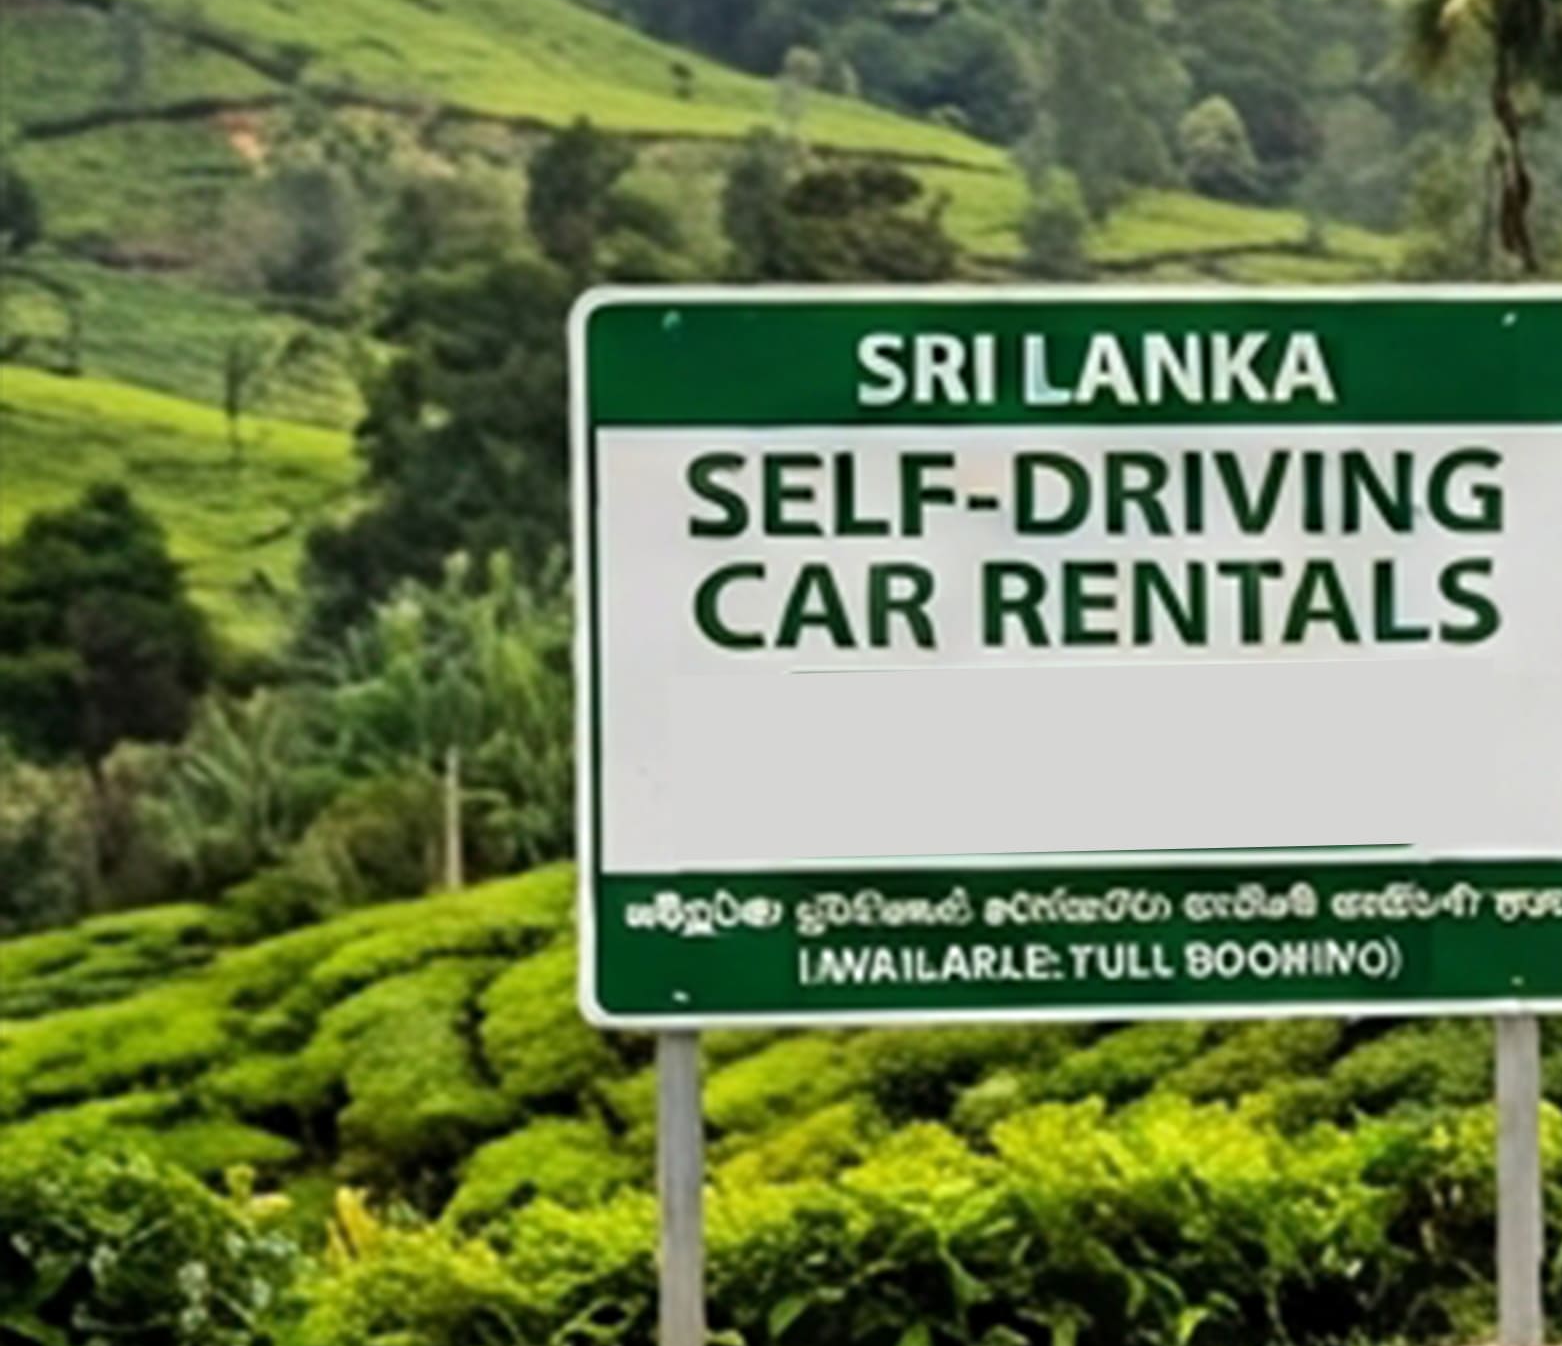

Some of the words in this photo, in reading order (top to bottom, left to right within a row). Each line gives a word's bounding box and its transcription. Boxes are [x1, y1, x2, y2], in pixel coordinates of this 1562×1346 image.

[857, 333, 996, 405] SRI
[1022, 332, 1336, 405] LANKA
[686, 448, 1504, 539] SELF-DRIVING
[692, 561, 937, 650] CAR
[981, 558, 1502, 648] RENTALS
